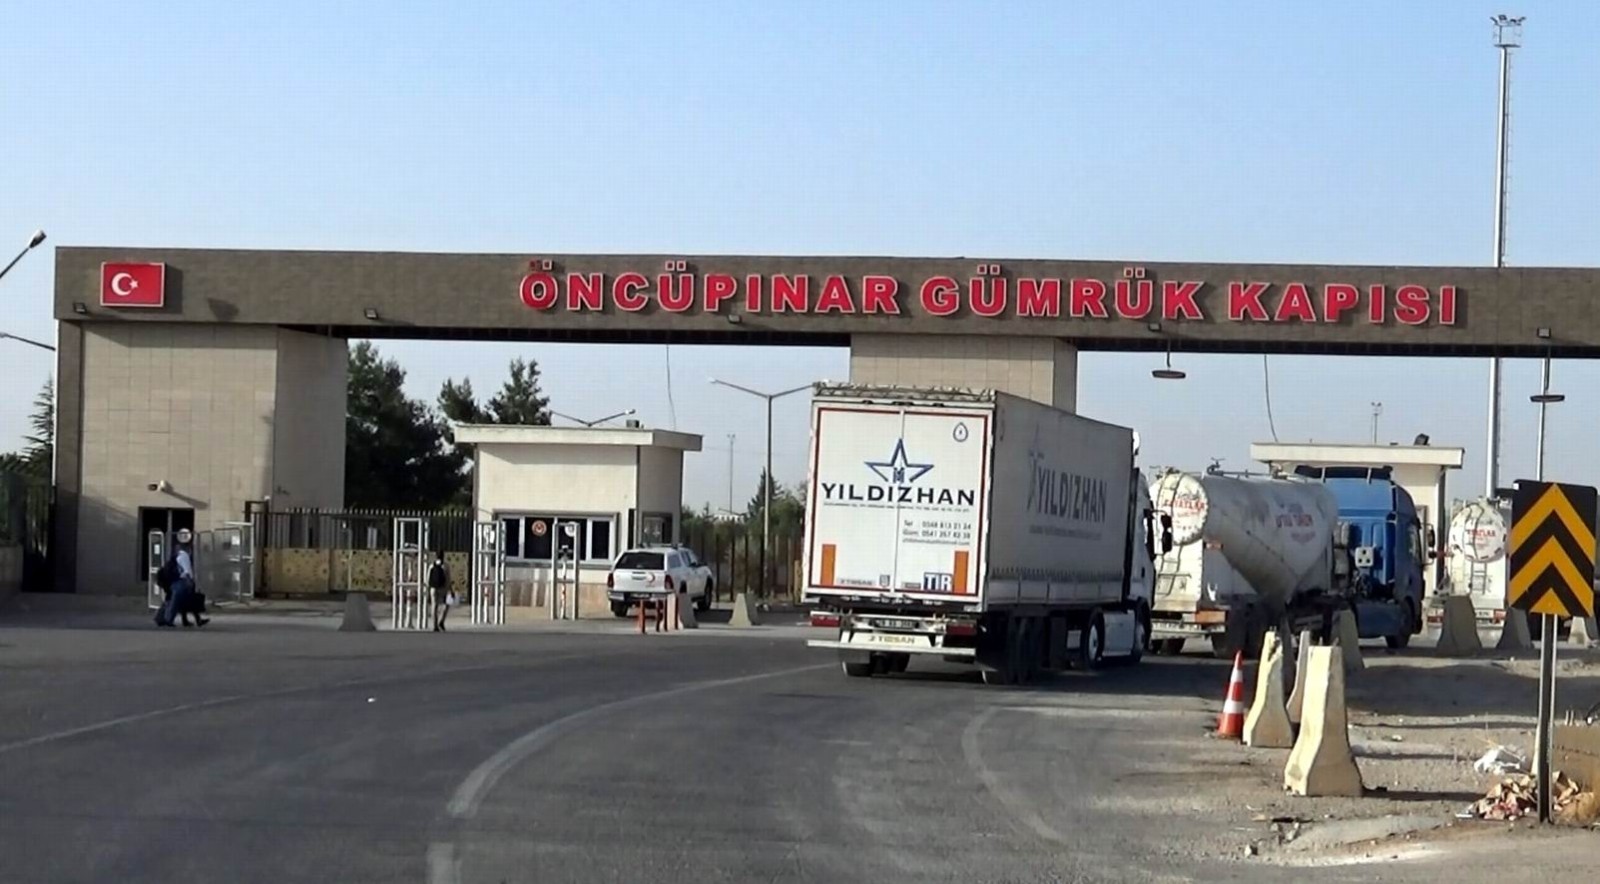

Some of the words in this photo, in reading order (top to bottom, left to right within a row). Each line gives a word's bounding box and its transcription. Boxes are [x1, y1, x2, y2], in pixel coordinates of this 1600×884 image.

[519, 259, 900, 314] ÖNCÜPINAR
[920, 264, 1204, 320] GÜMRÜK
[1228, 280, 1457, 326] KAPISI
[822, 482, 975, 506] YILDIZHAN
[1038, 465, 1108, 523] YILDIZHAN
[923, 572, 952, 592] TIR
